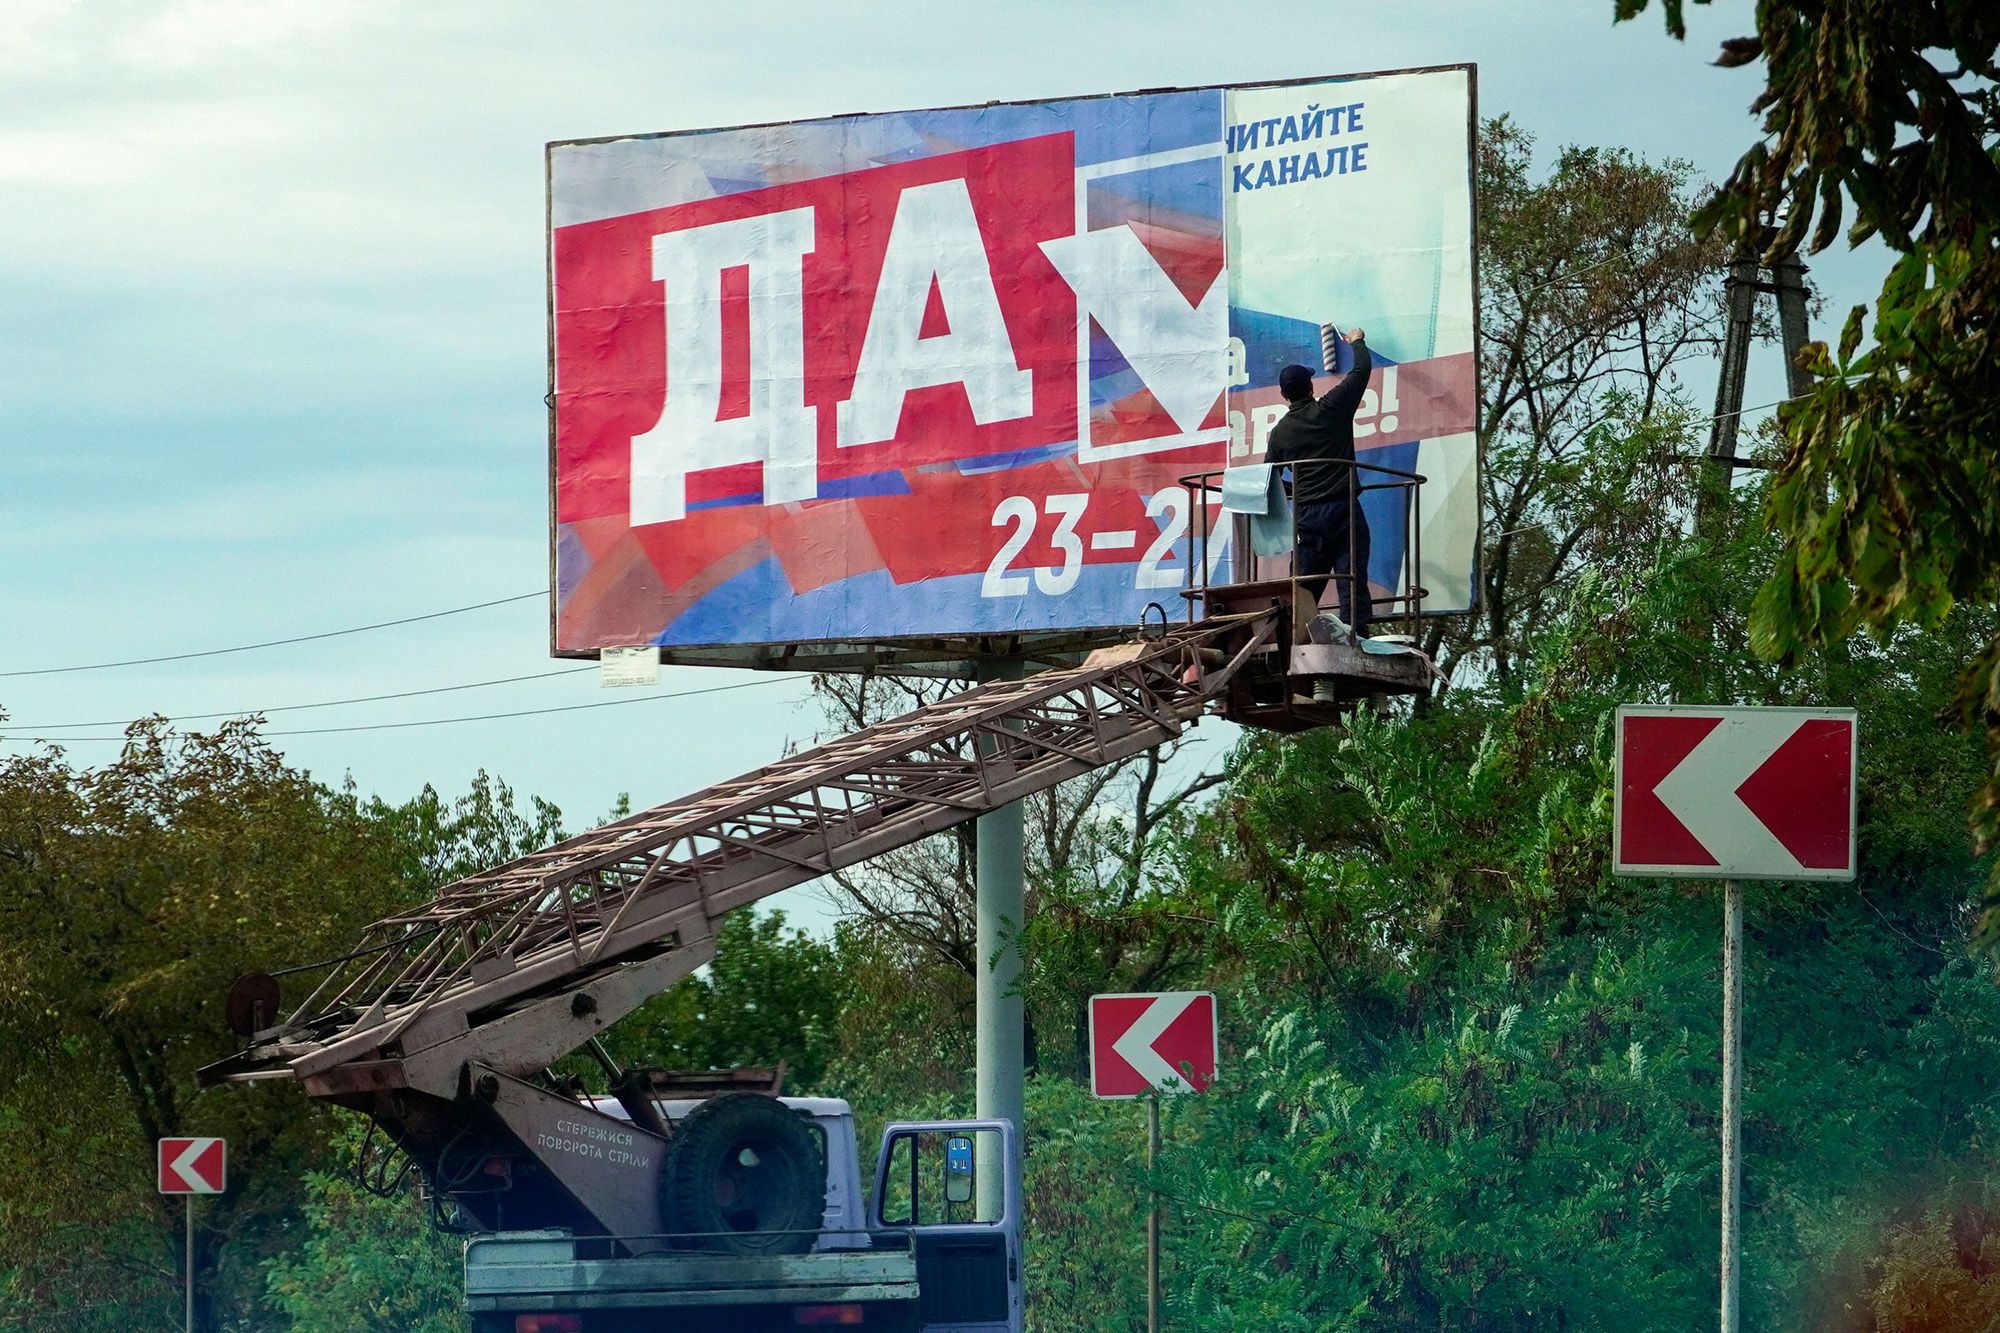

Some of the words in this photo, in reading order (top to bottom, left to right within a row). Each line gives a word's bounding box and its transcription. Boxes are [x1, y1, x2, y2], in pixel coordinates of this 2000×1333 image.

[1232, 142, 1369, 193] КАНАЛЕ
[629, 177, 1034, 527] ДА
[537, 1133, 602, 1160] ПОВОРОТА
[557, 1119, 634, 1146] СТЕРЕЖИСЯ
